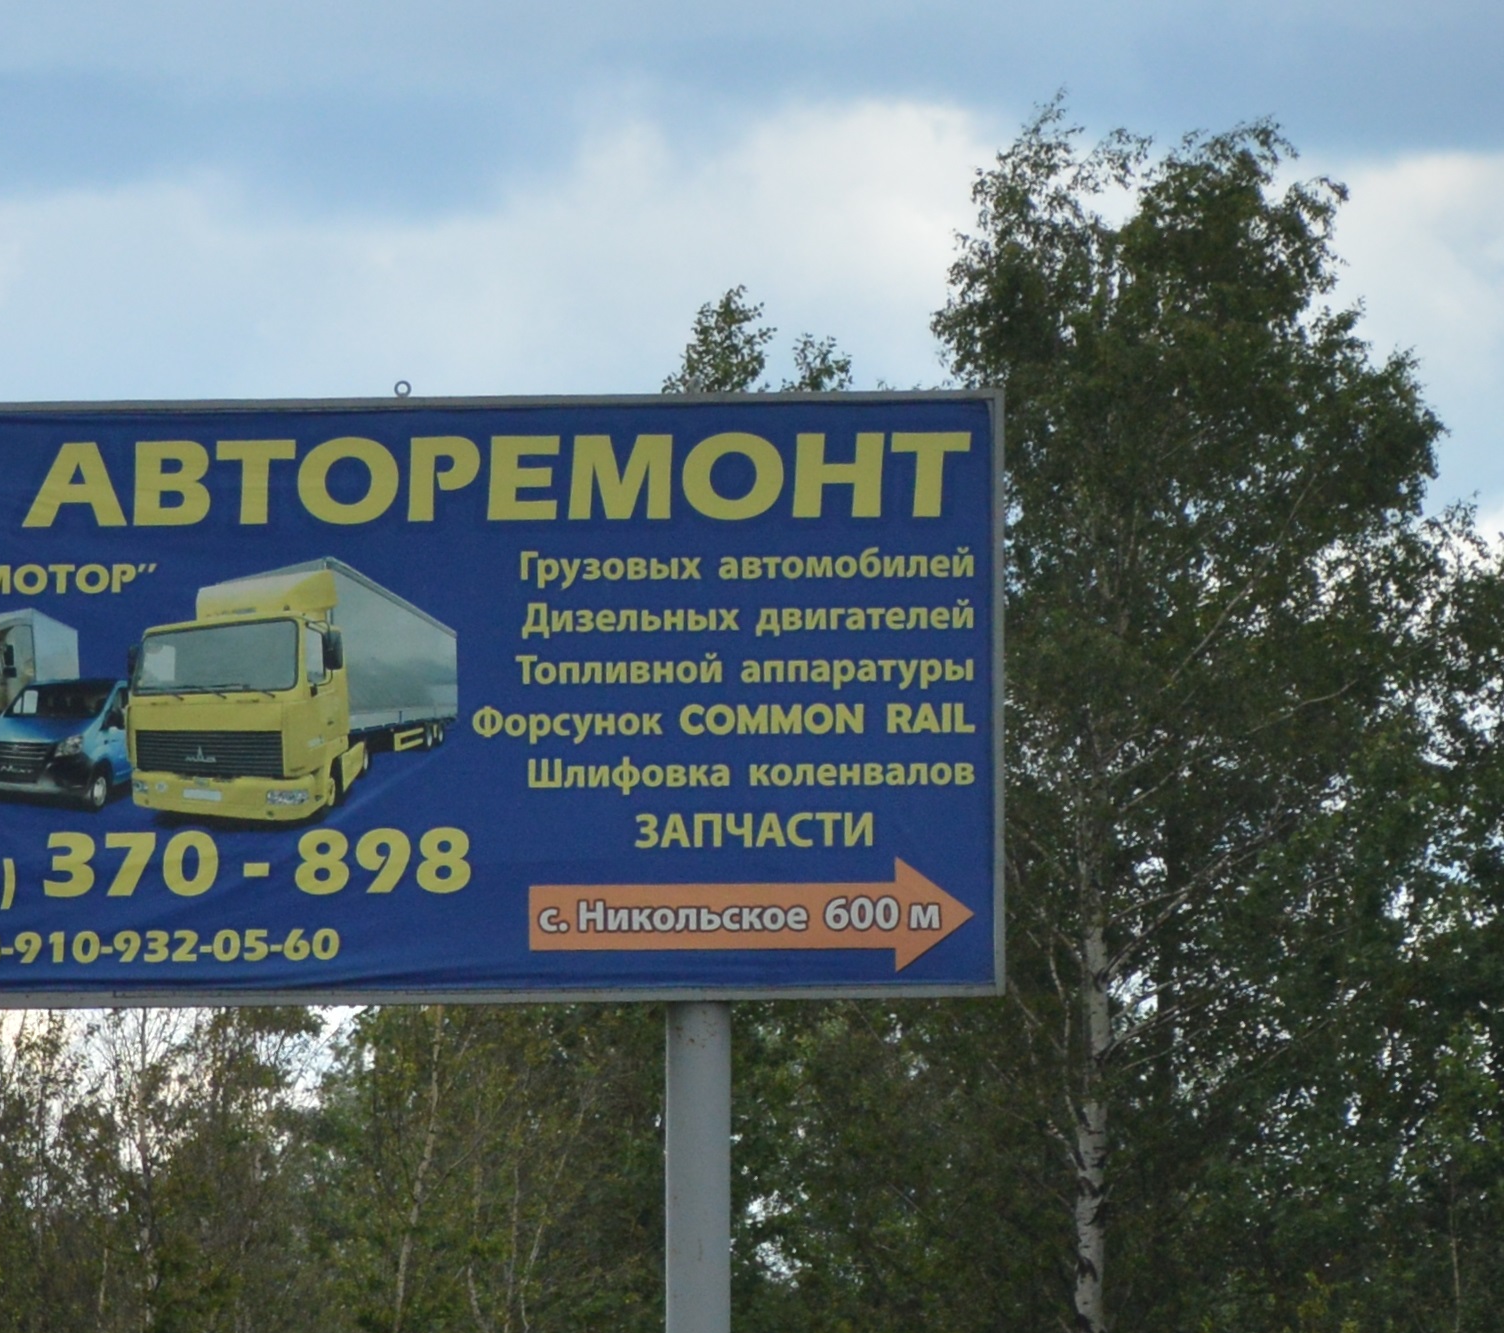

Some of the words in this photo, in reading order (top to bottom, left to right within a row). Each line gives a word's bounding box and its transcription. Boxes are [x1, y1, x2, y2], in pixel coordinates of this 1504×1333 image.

[21, 431, 972, 528] АВТОРЕМОНТ
[519, 550, 702, 590] Грузовых
[718, 546, 975, 581] автомобилей
[521, 601, 740, 639] Дизельных
[755, 598, 975, 637] двигателей
[515, 651, 723, 685] Топливной
[740, 656, 975, 690] аппаратуры
[472, 705, 664, 745] Форсунок
[679, 703, 865, 735] COMMON
[887, 702, 976, 734] RAIL
[527, 756, 731, 795] Шлифовка
[749, 761, 976, 787] коленвалов
[634, 811, 875, 849] ЗАПЧАСТИ
[42, 830, 219, 898] 370
[292, 827, 472, 896] 898
[538, 907, 569, 932] с.
[577, 900, 809, 932] Никольское
[824, 896, 900, 931] 600
[908, 902, 942, 930] м
